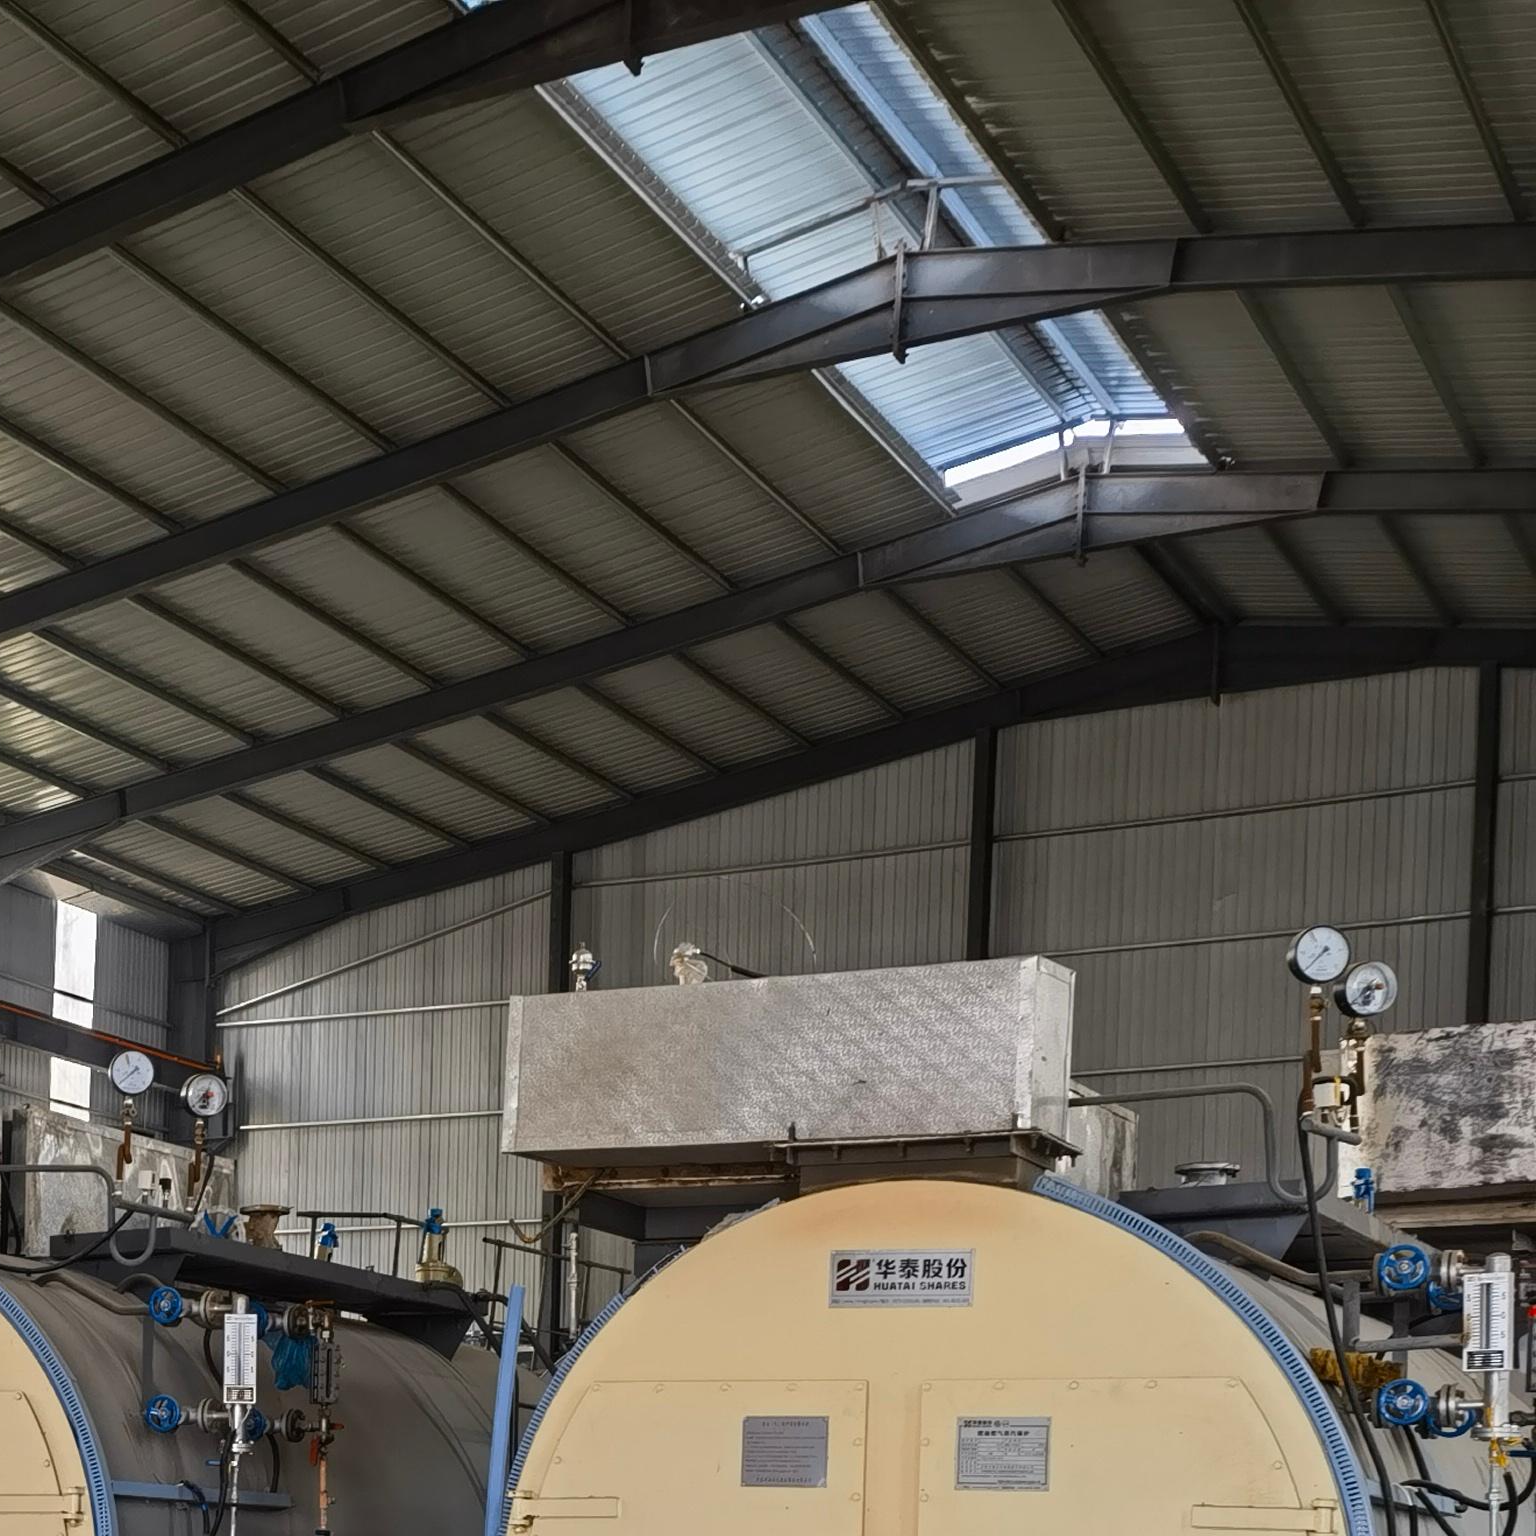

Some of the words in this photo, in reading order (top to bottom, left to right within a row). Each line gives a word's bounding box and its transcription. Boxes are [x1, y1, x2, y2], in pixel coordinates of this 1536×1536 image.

[875, 1258, 967, 1280] 华泰股份
[873, 1281, 916, 1291] HUATAI
[919, 1281, 967, 1291] SHARES
